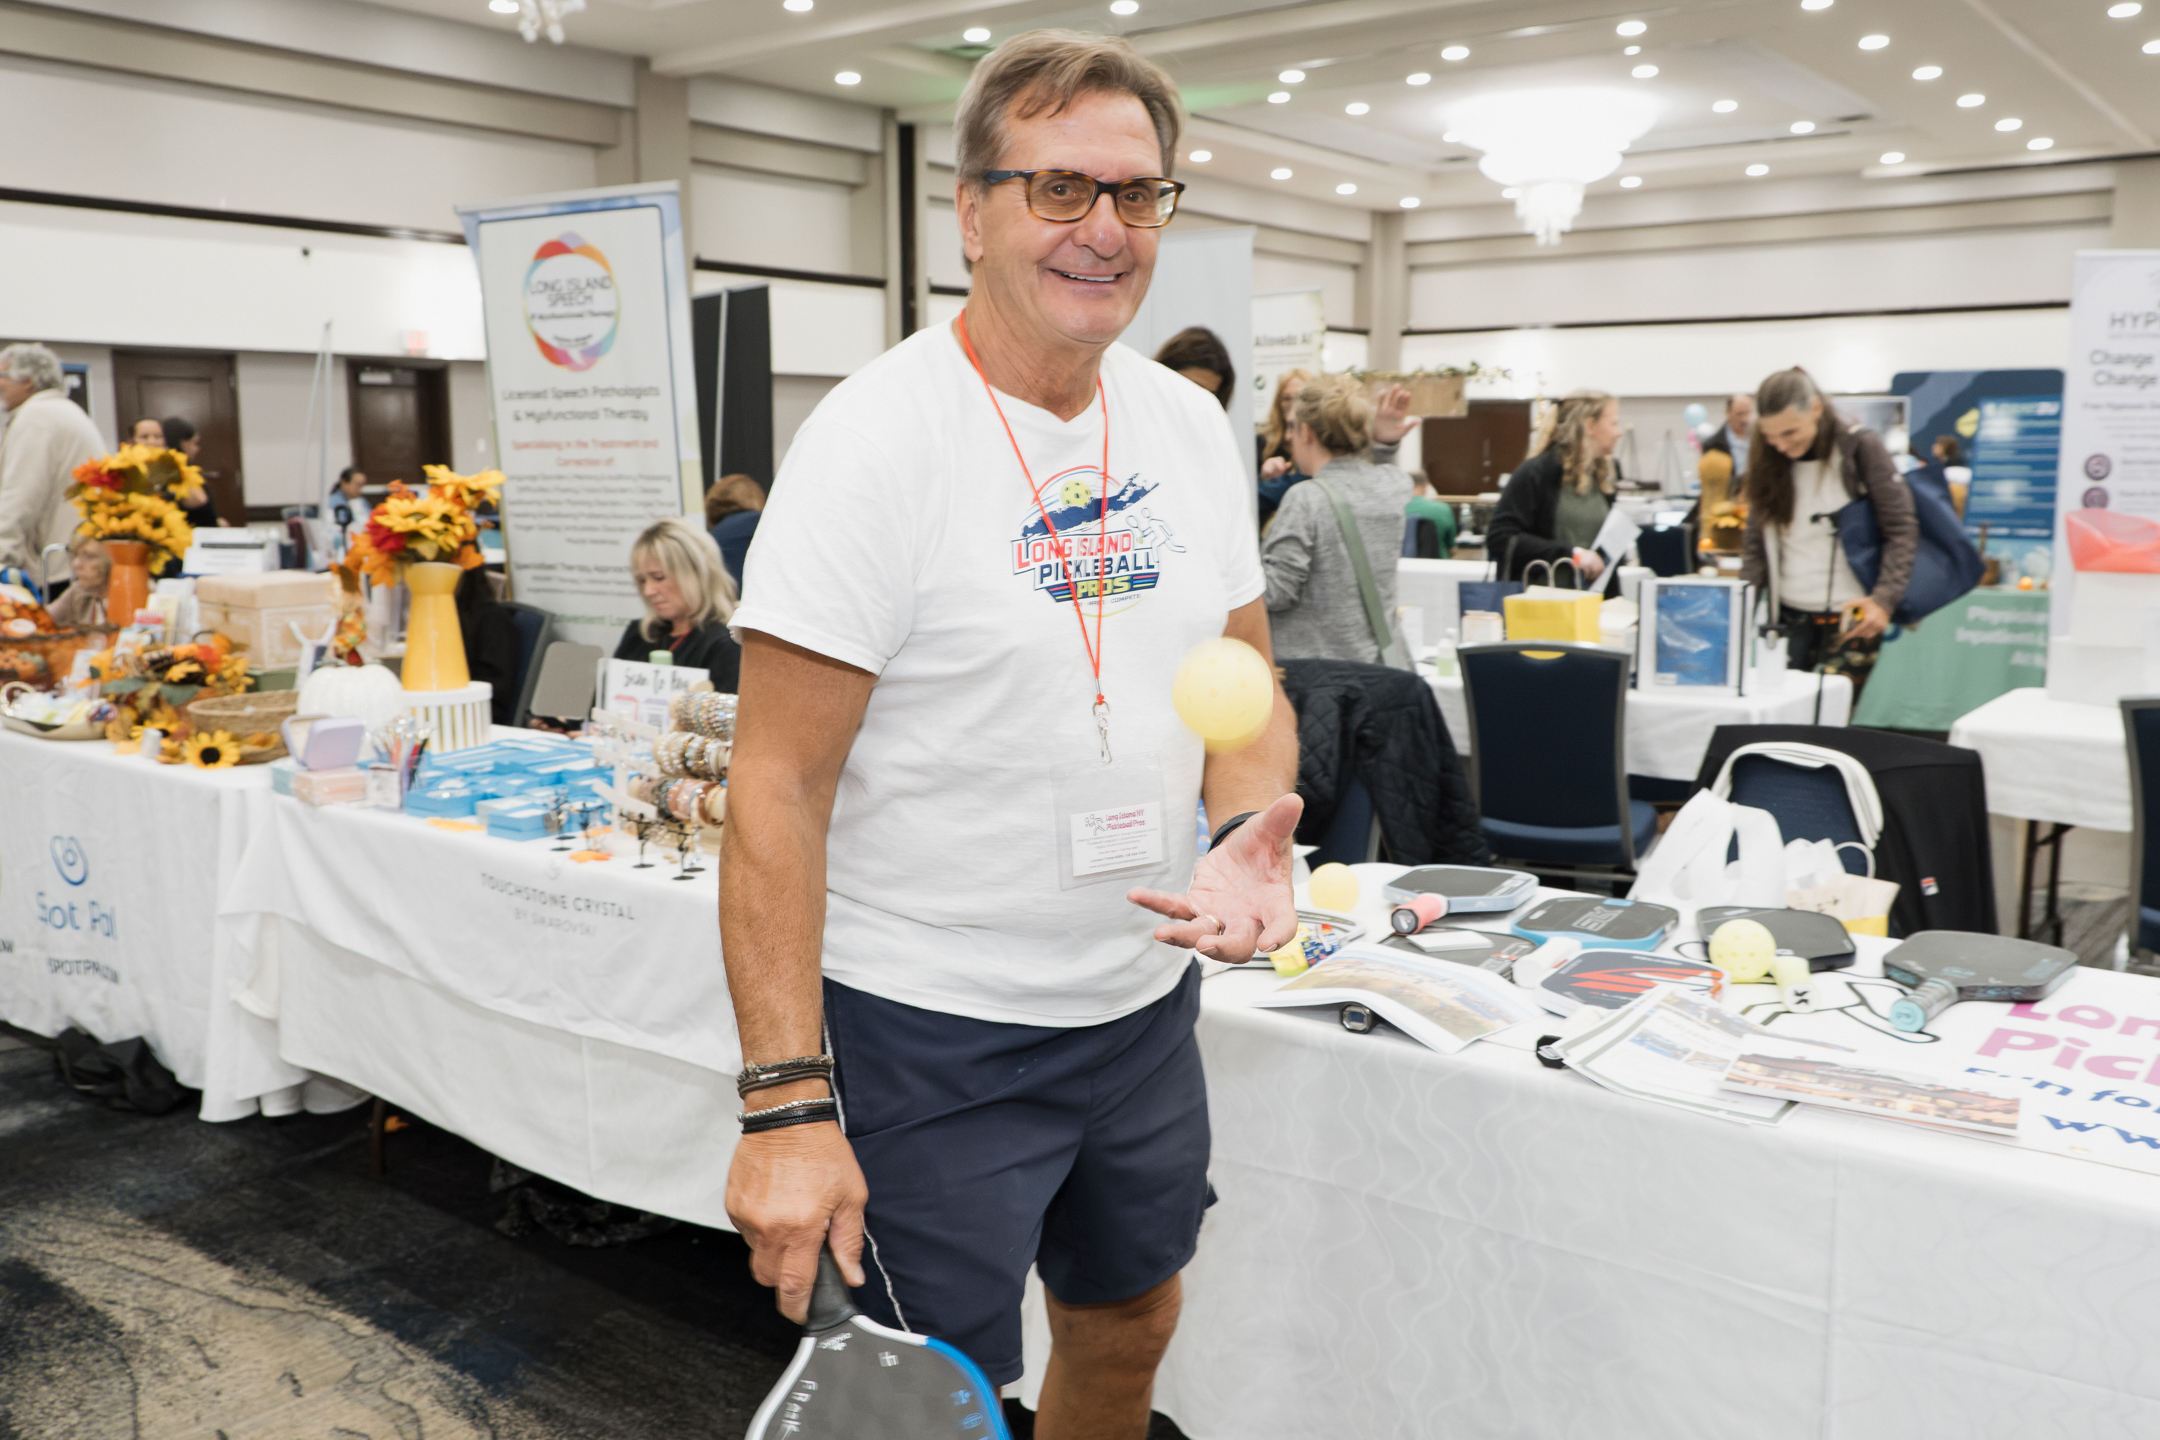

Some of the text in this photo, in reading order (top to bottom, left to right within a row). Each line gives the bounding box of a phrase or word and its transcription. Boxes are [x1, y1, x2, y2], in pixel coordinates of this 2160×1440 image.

[530, 275, 612, 294] LONG ISLAND
[548, 292, 593, 307] SPEECH
[2090, 349, 2153, 369] Change
[2094, 370, 2158, 389] Change
[502, 389, 548, 400] Licensed
[552, 387, 588, 400] Speech
[602, 407, 649, 422] Therapy
[1016, 532, 1132, 570] LONG ISLAND
[1040, 551, 1155, 585] PICKLEBALL
[1076, 575, 1133, 598] PROS
[1110, 594, 1142, 604] COMPETE
[1106, 808, 1145, 822] Long Island NY
[1106, 819, 1146, 831] Pickleball Pros
[480, 872, 635, 920] TOUCHSTONE CRYSTAL
[2088, 1089, 2160, 1114] fo
